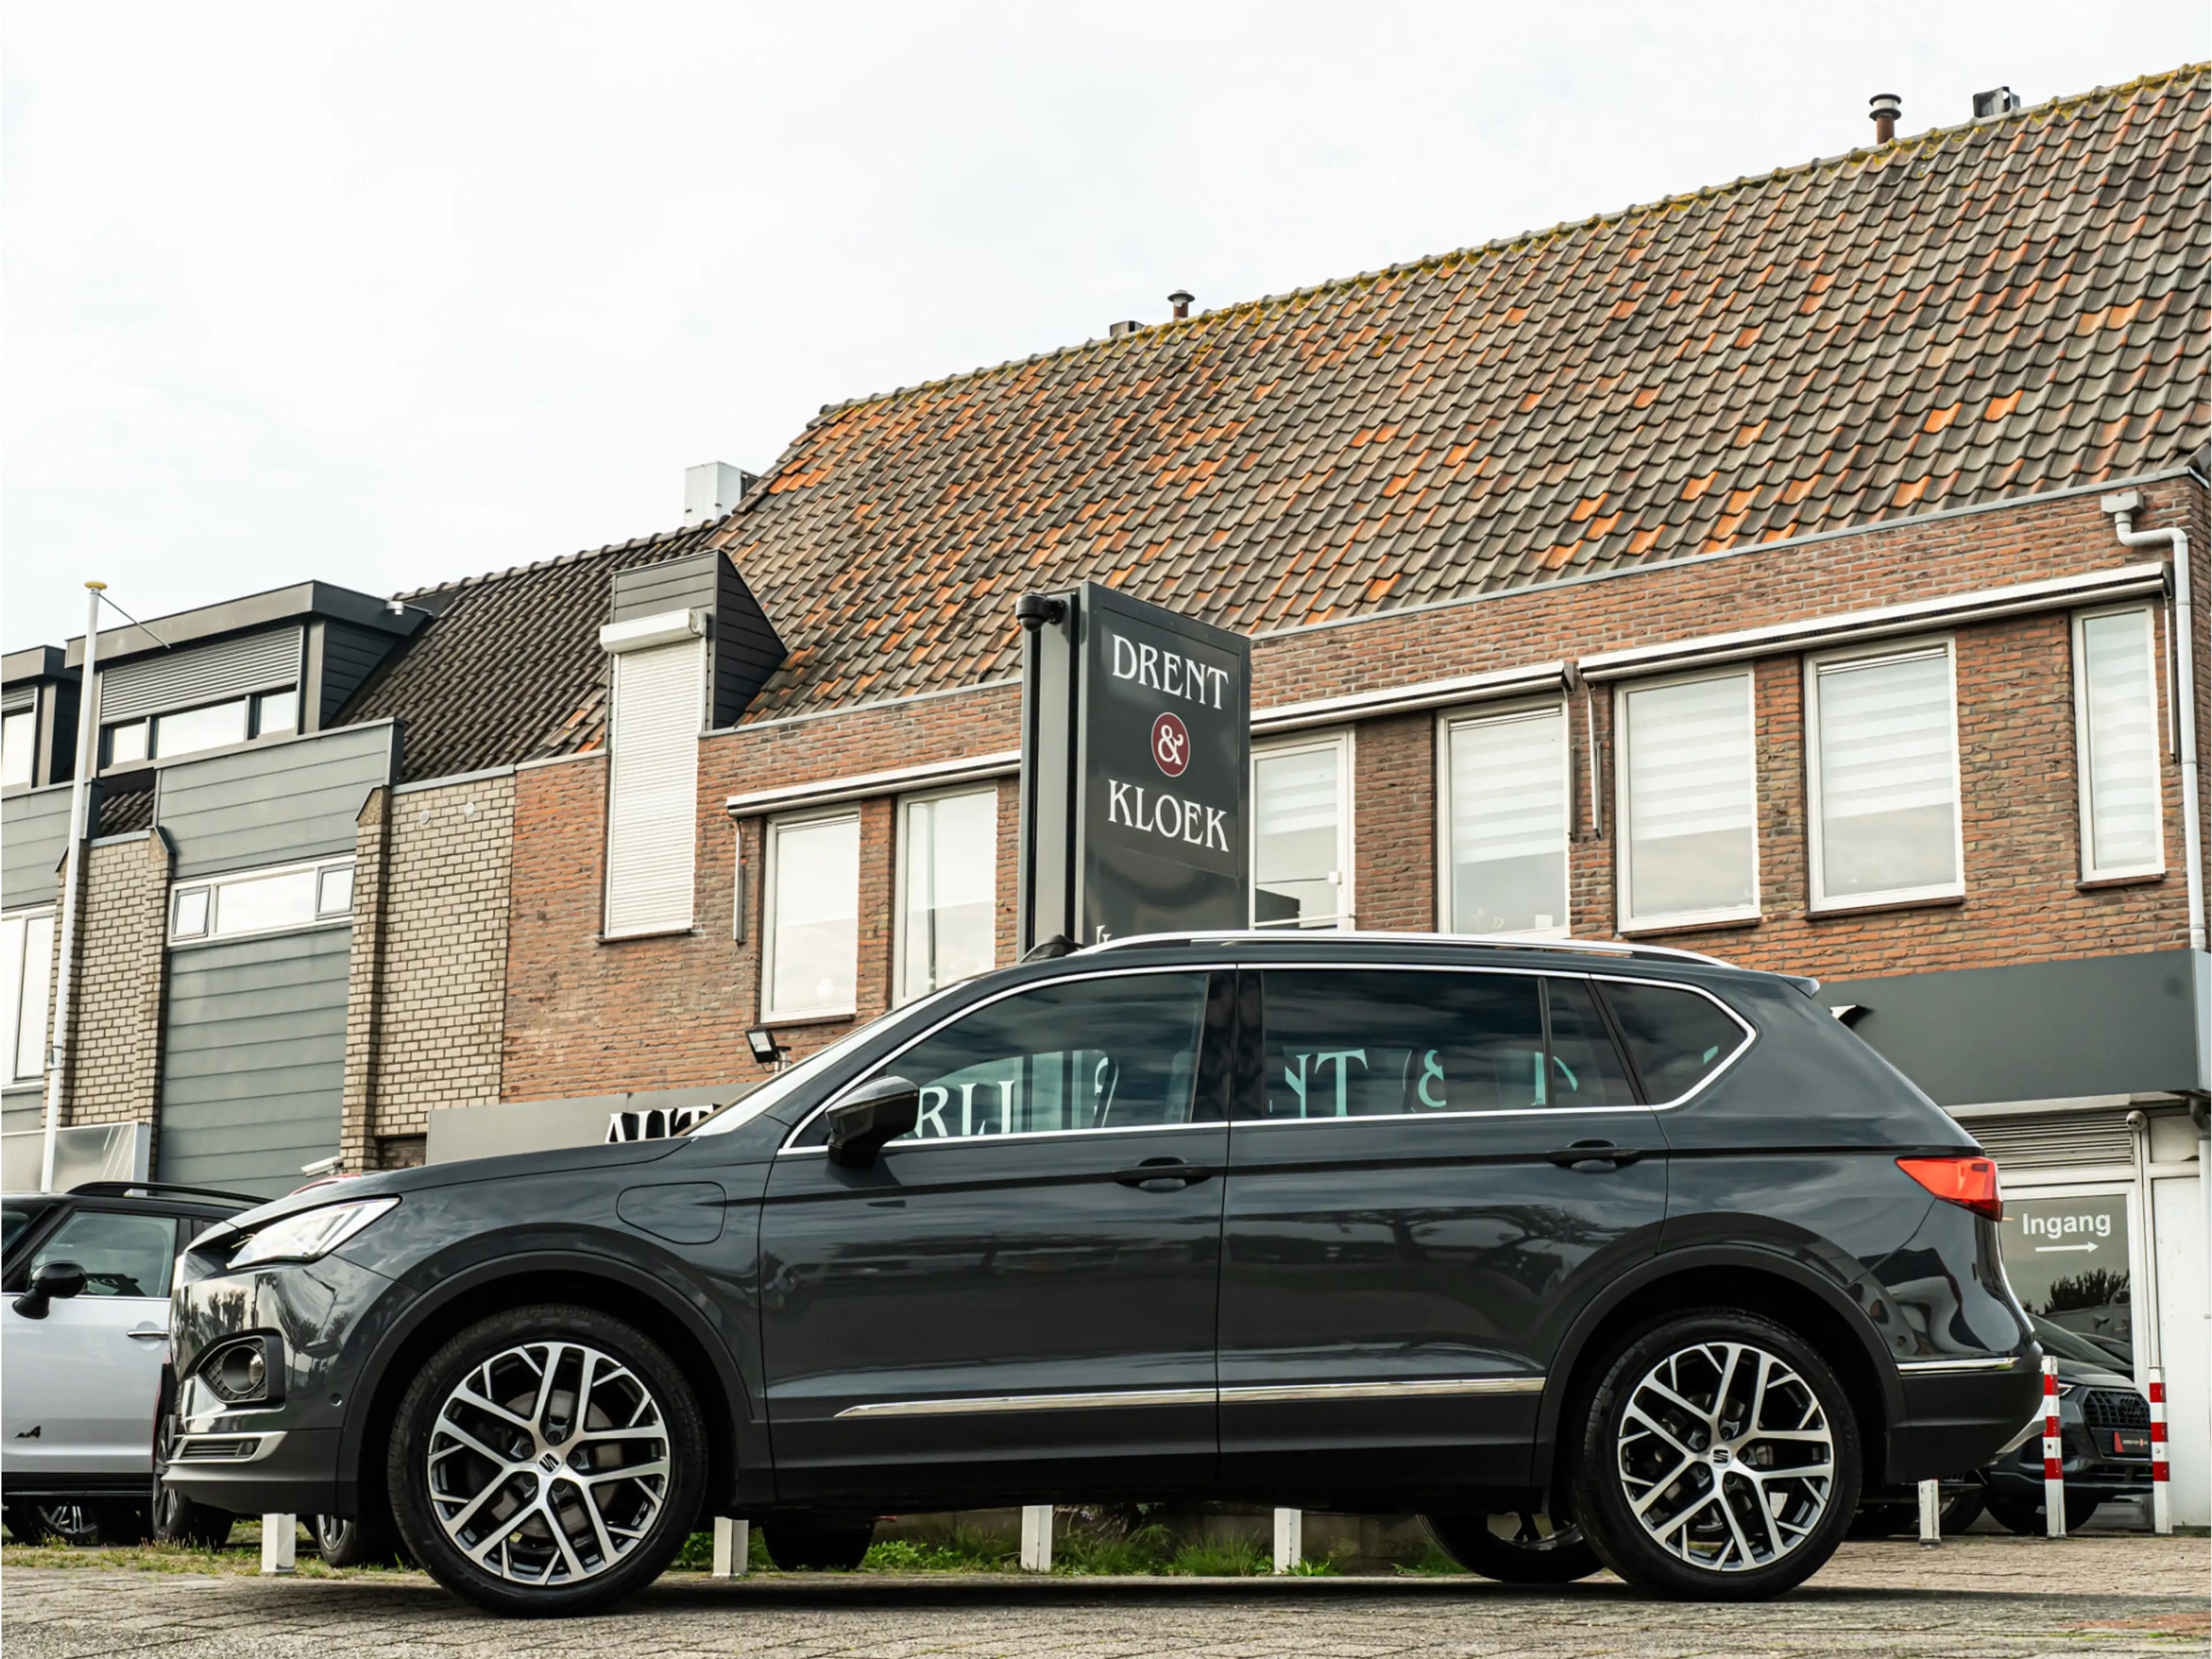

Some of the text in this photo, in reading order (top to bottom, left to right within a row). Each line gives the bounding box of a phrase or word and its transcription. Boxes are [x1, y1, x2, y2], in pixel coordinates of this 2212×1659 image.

[1112, 634, 1229, 710] DRENT
[1158, 725, 1184, 765] &
[1108, 779, 1229, 853] KLOEK
[2022, 1213, 2111, 1240] Ingang
